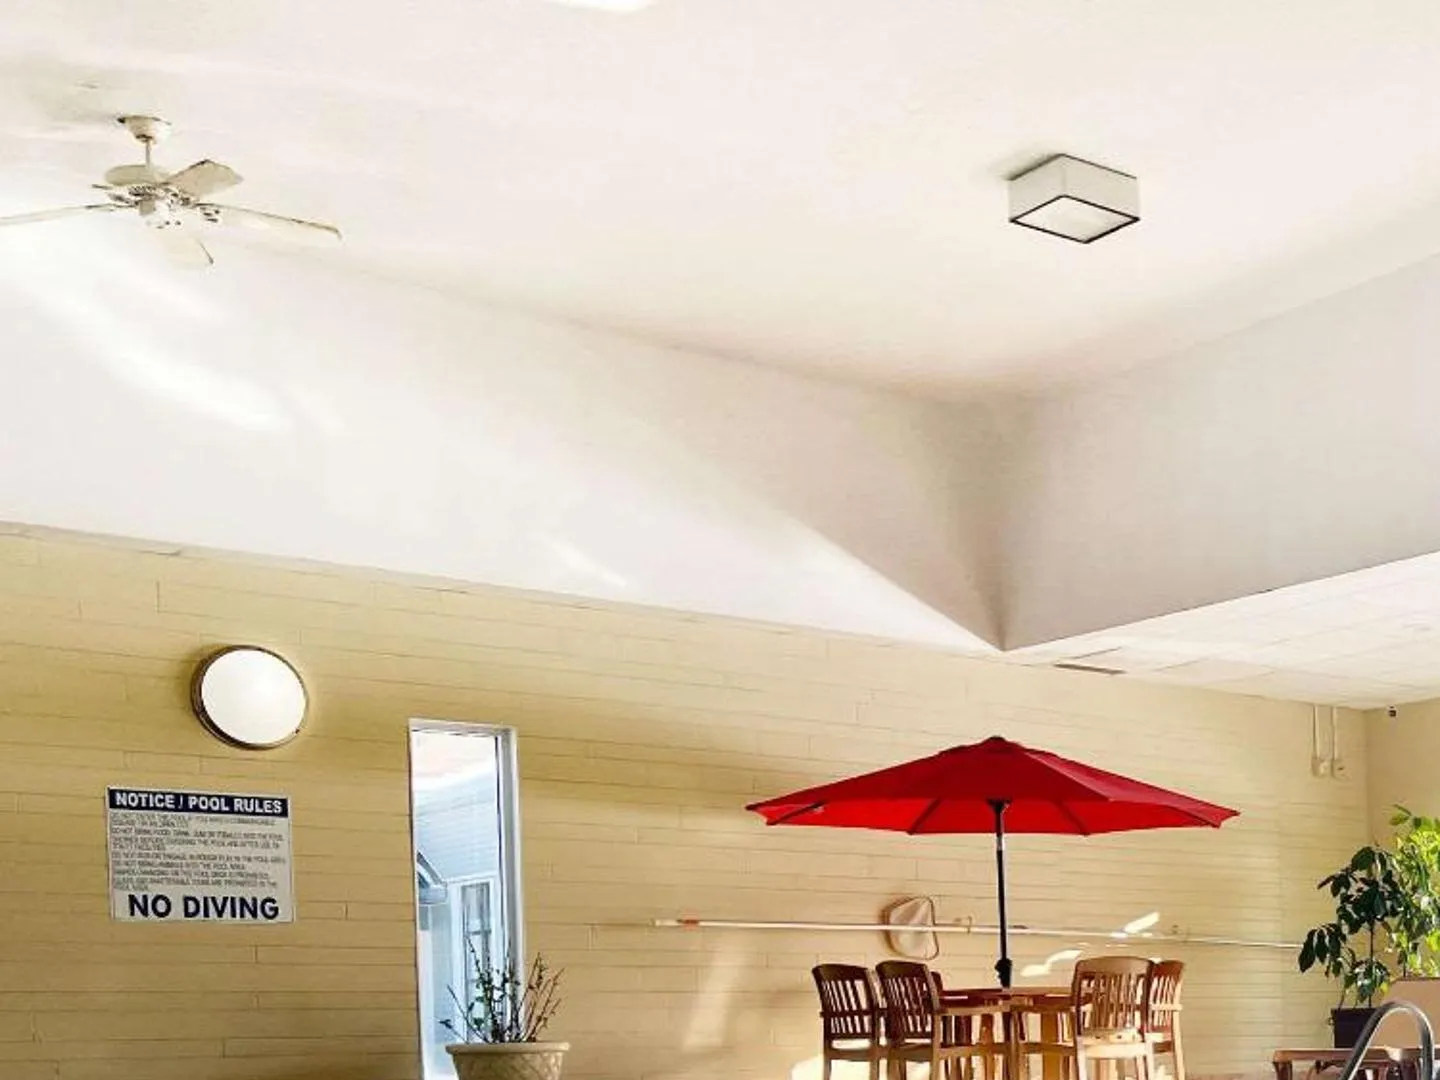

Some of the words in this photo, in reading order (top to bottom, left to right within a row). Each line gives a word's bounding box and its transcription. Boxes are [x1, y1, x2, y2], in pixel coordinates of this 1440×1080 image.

[115, 792, 175, 809] NOTICE
[188, 796, 230, 812] POOL
[234, 798, 283, 813] RULES
[128, 894, 172, 918] NO
[183, 896, 279, 920] DIVING
